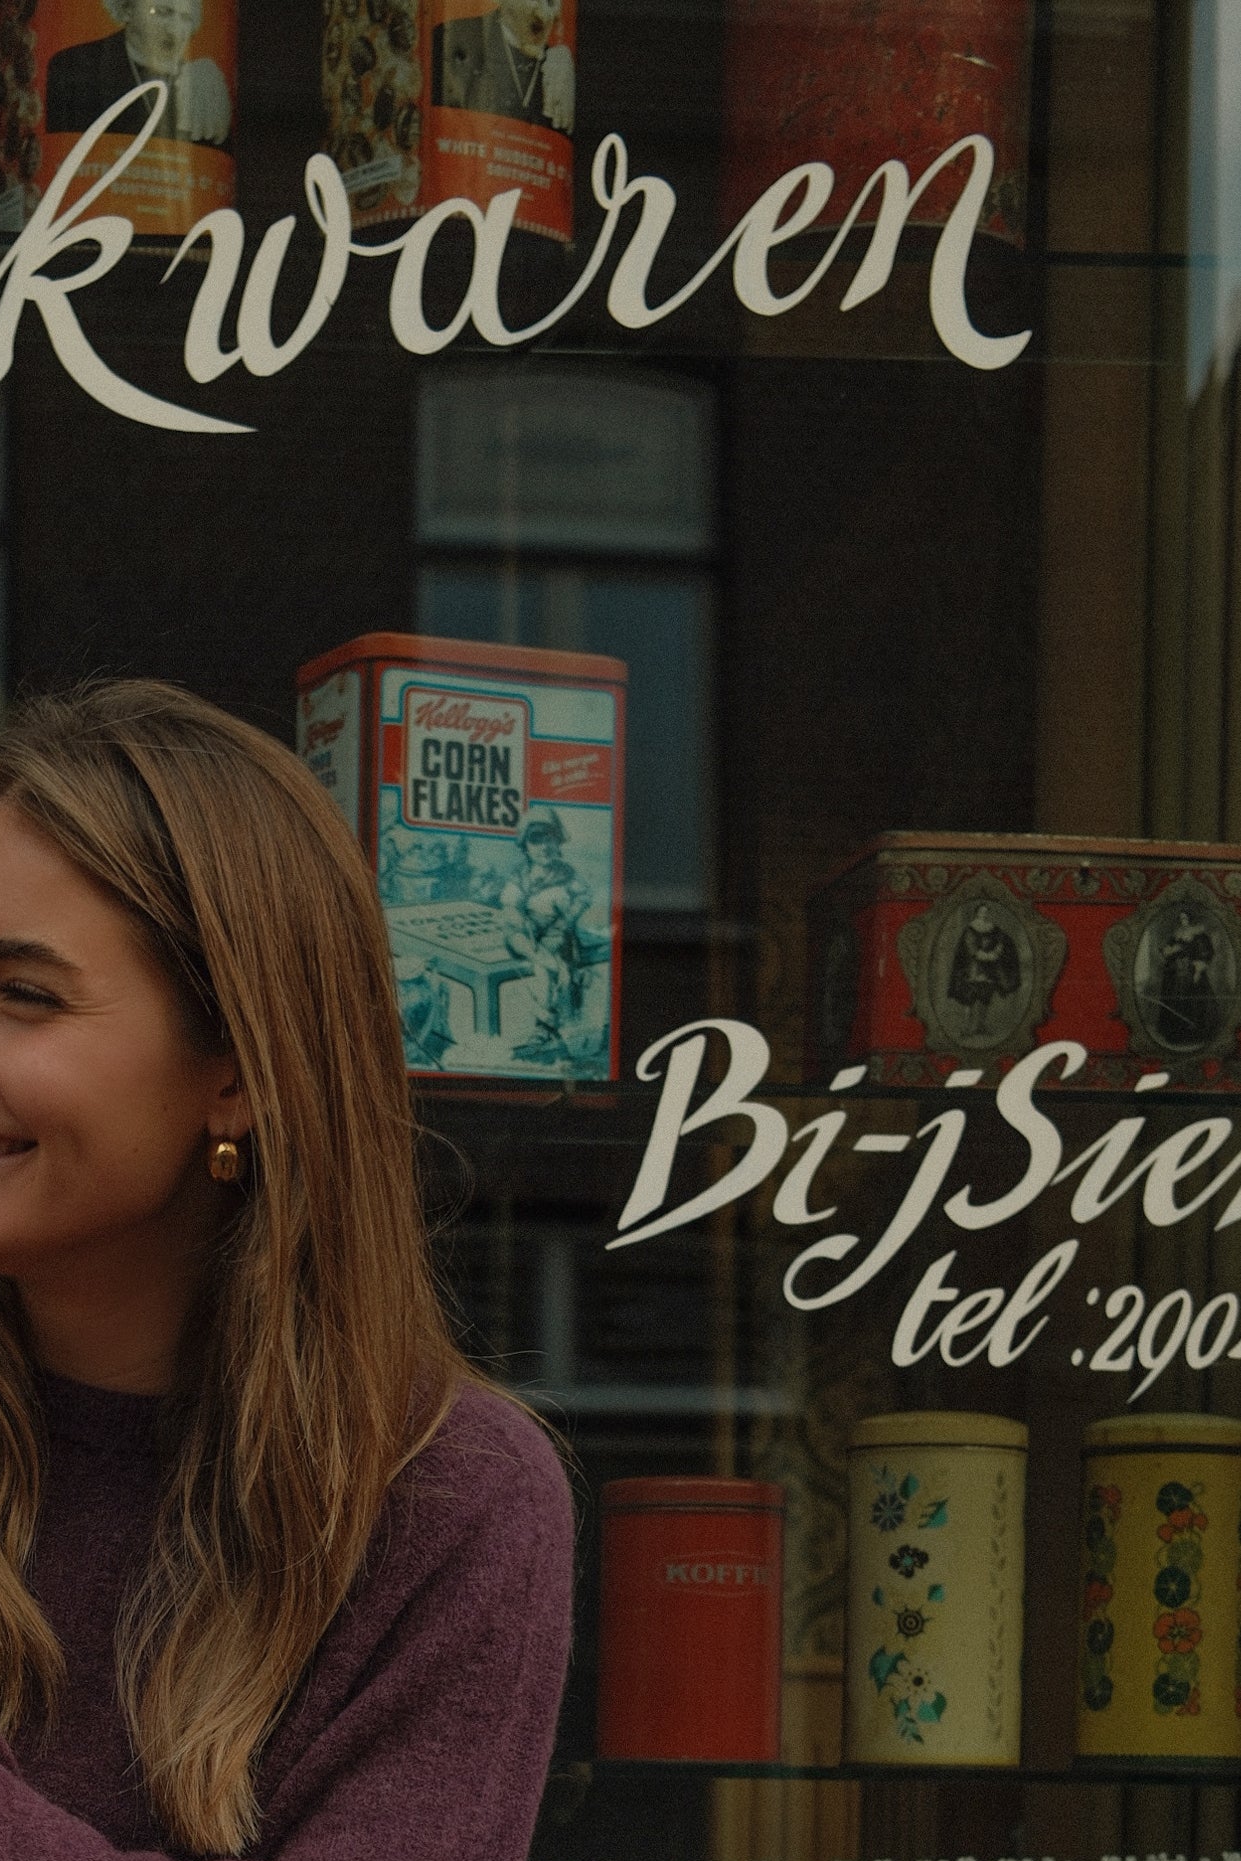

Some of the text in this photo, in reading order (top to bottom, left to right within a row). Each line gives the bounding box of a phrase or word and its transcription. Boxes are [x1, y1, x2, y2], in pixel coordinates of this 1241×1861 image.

[415, 698, 516, 743] Kellogg's
[422, 738, 511, 786] CORN
[412, 778, 520, 828] FLAKES
